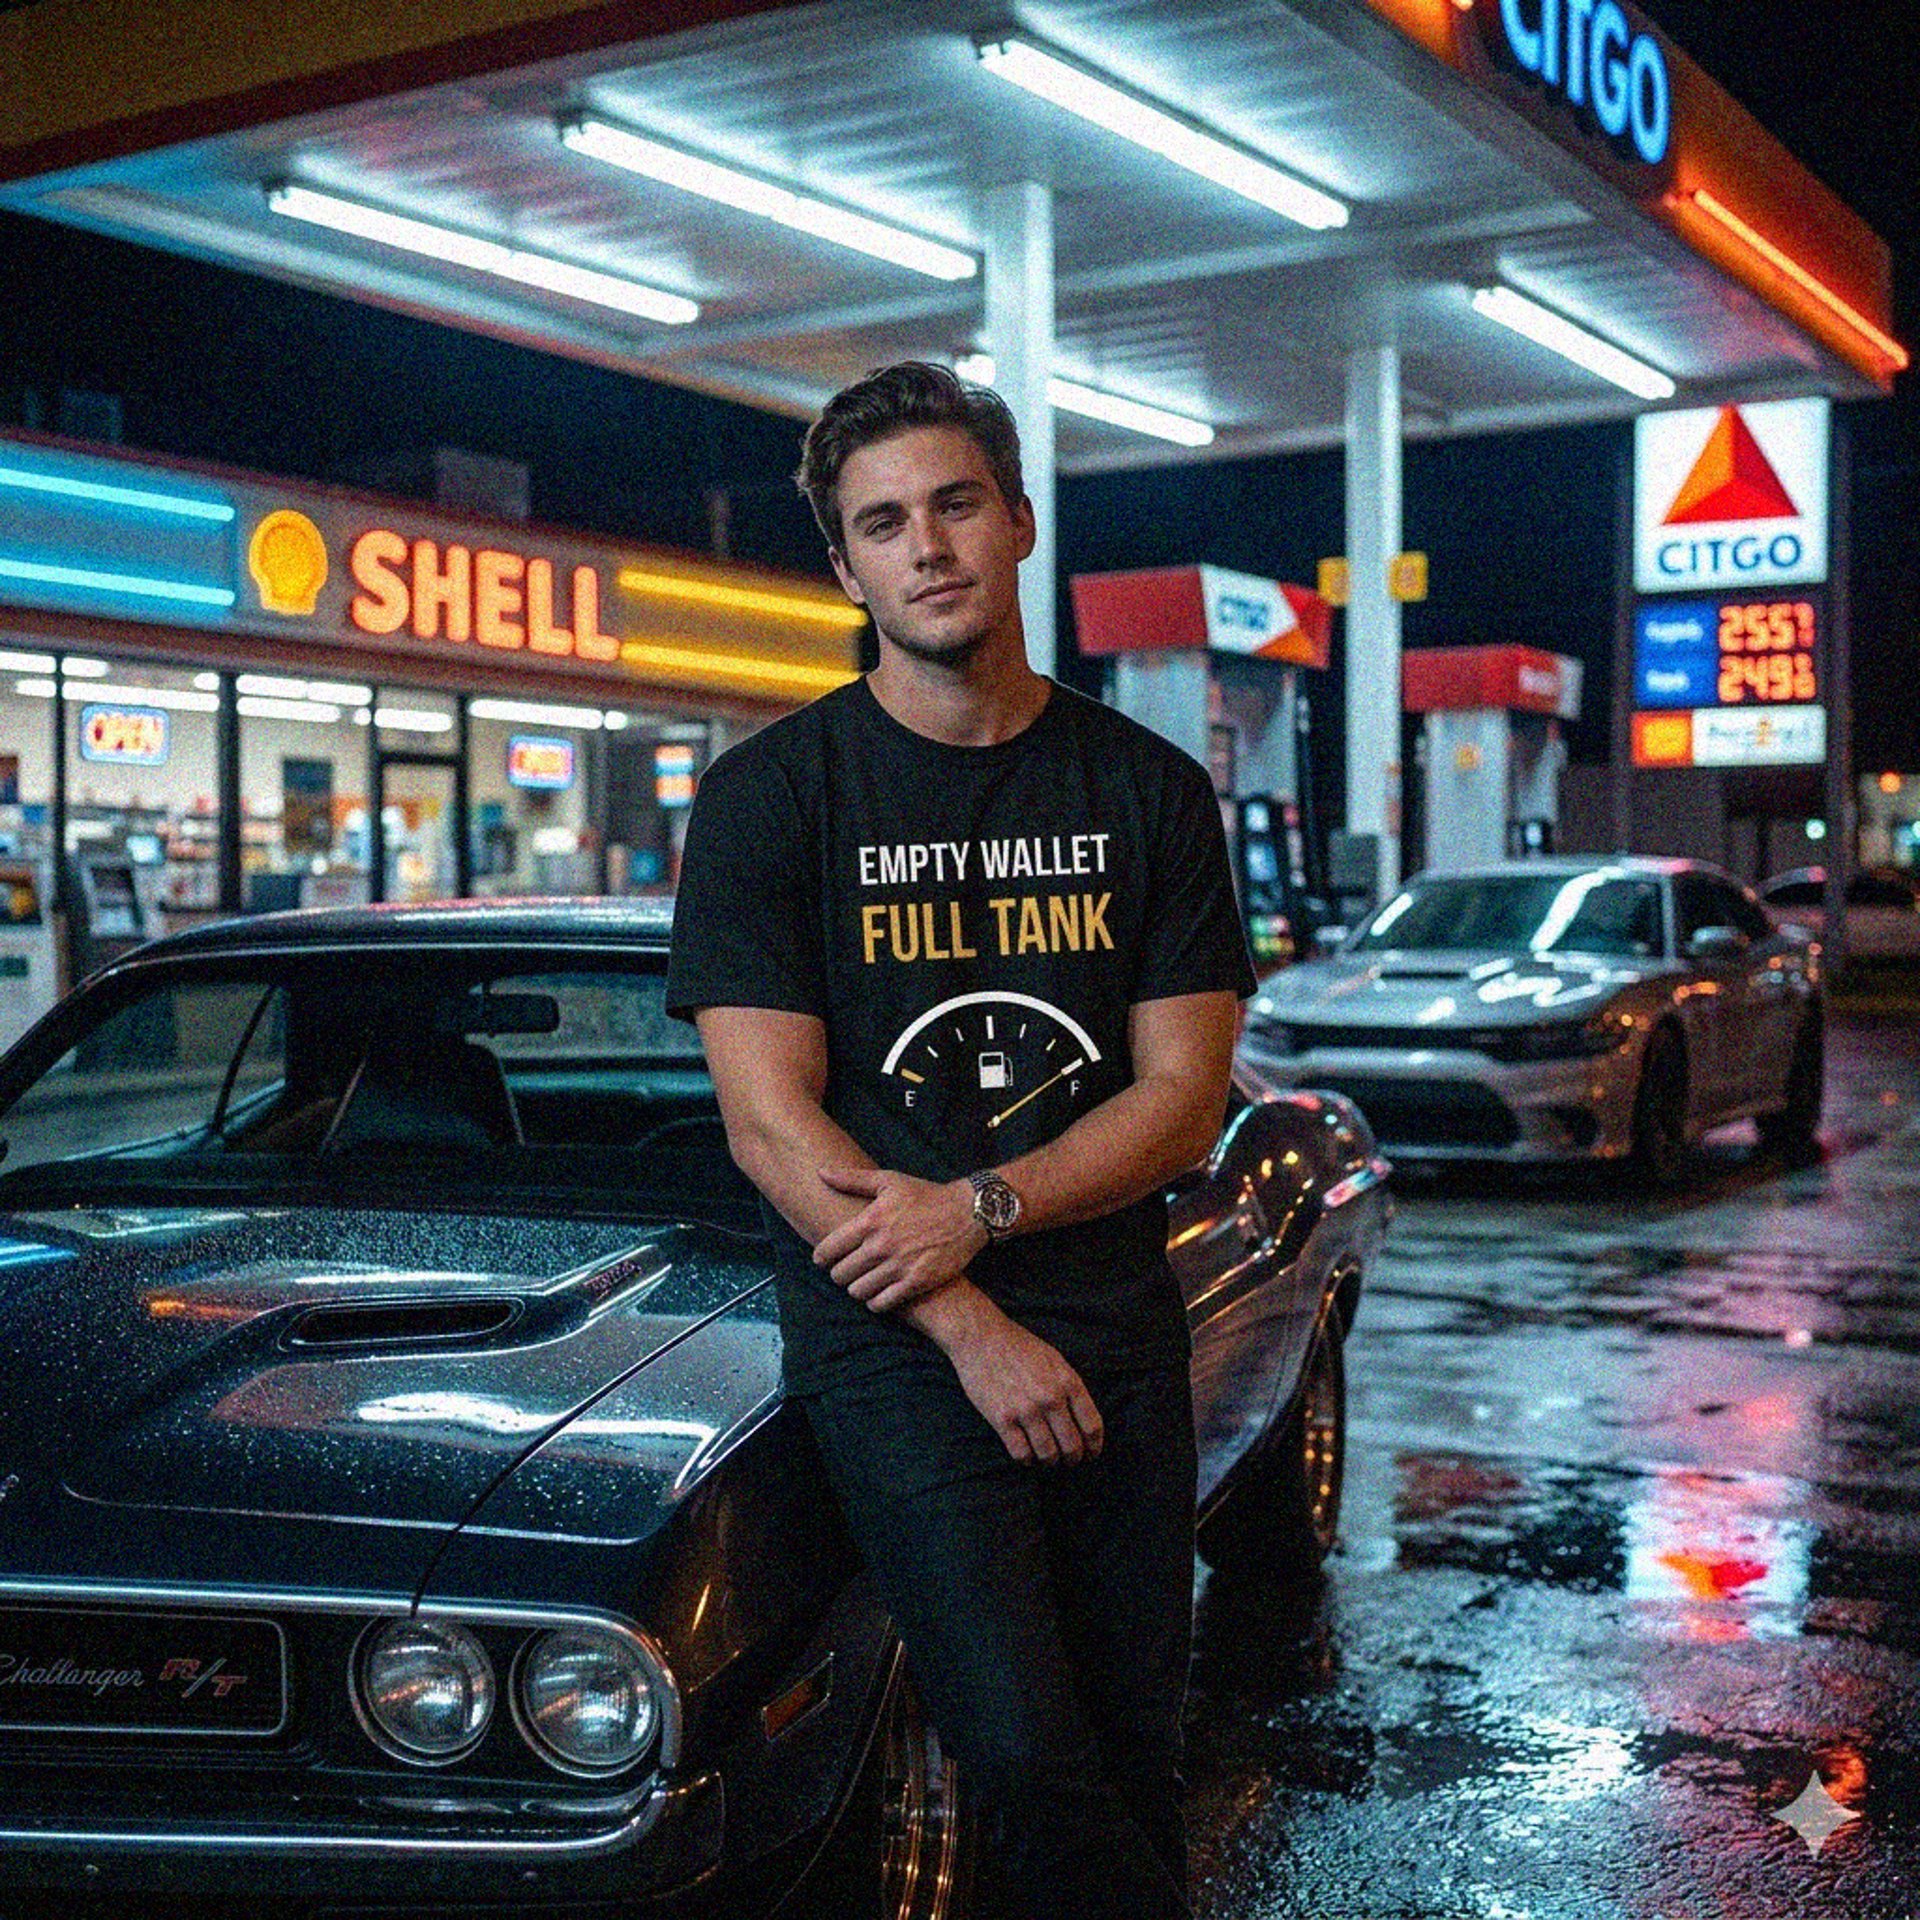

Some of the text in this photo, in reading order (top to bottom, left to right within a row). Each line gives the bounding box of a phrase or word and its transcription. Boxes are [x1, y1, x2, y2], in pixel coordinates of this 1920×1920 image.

[1658, 535, 1801, 575] CITGO
[351, 529, 621, 661] SHELL
[859, 834, 1109, 885] EMPTY WALLET
[862, 892, 1115, 964] FULL TANK
[904, 1090, 916, 1107] E
[1070, 1079, 1081, 1096] F
